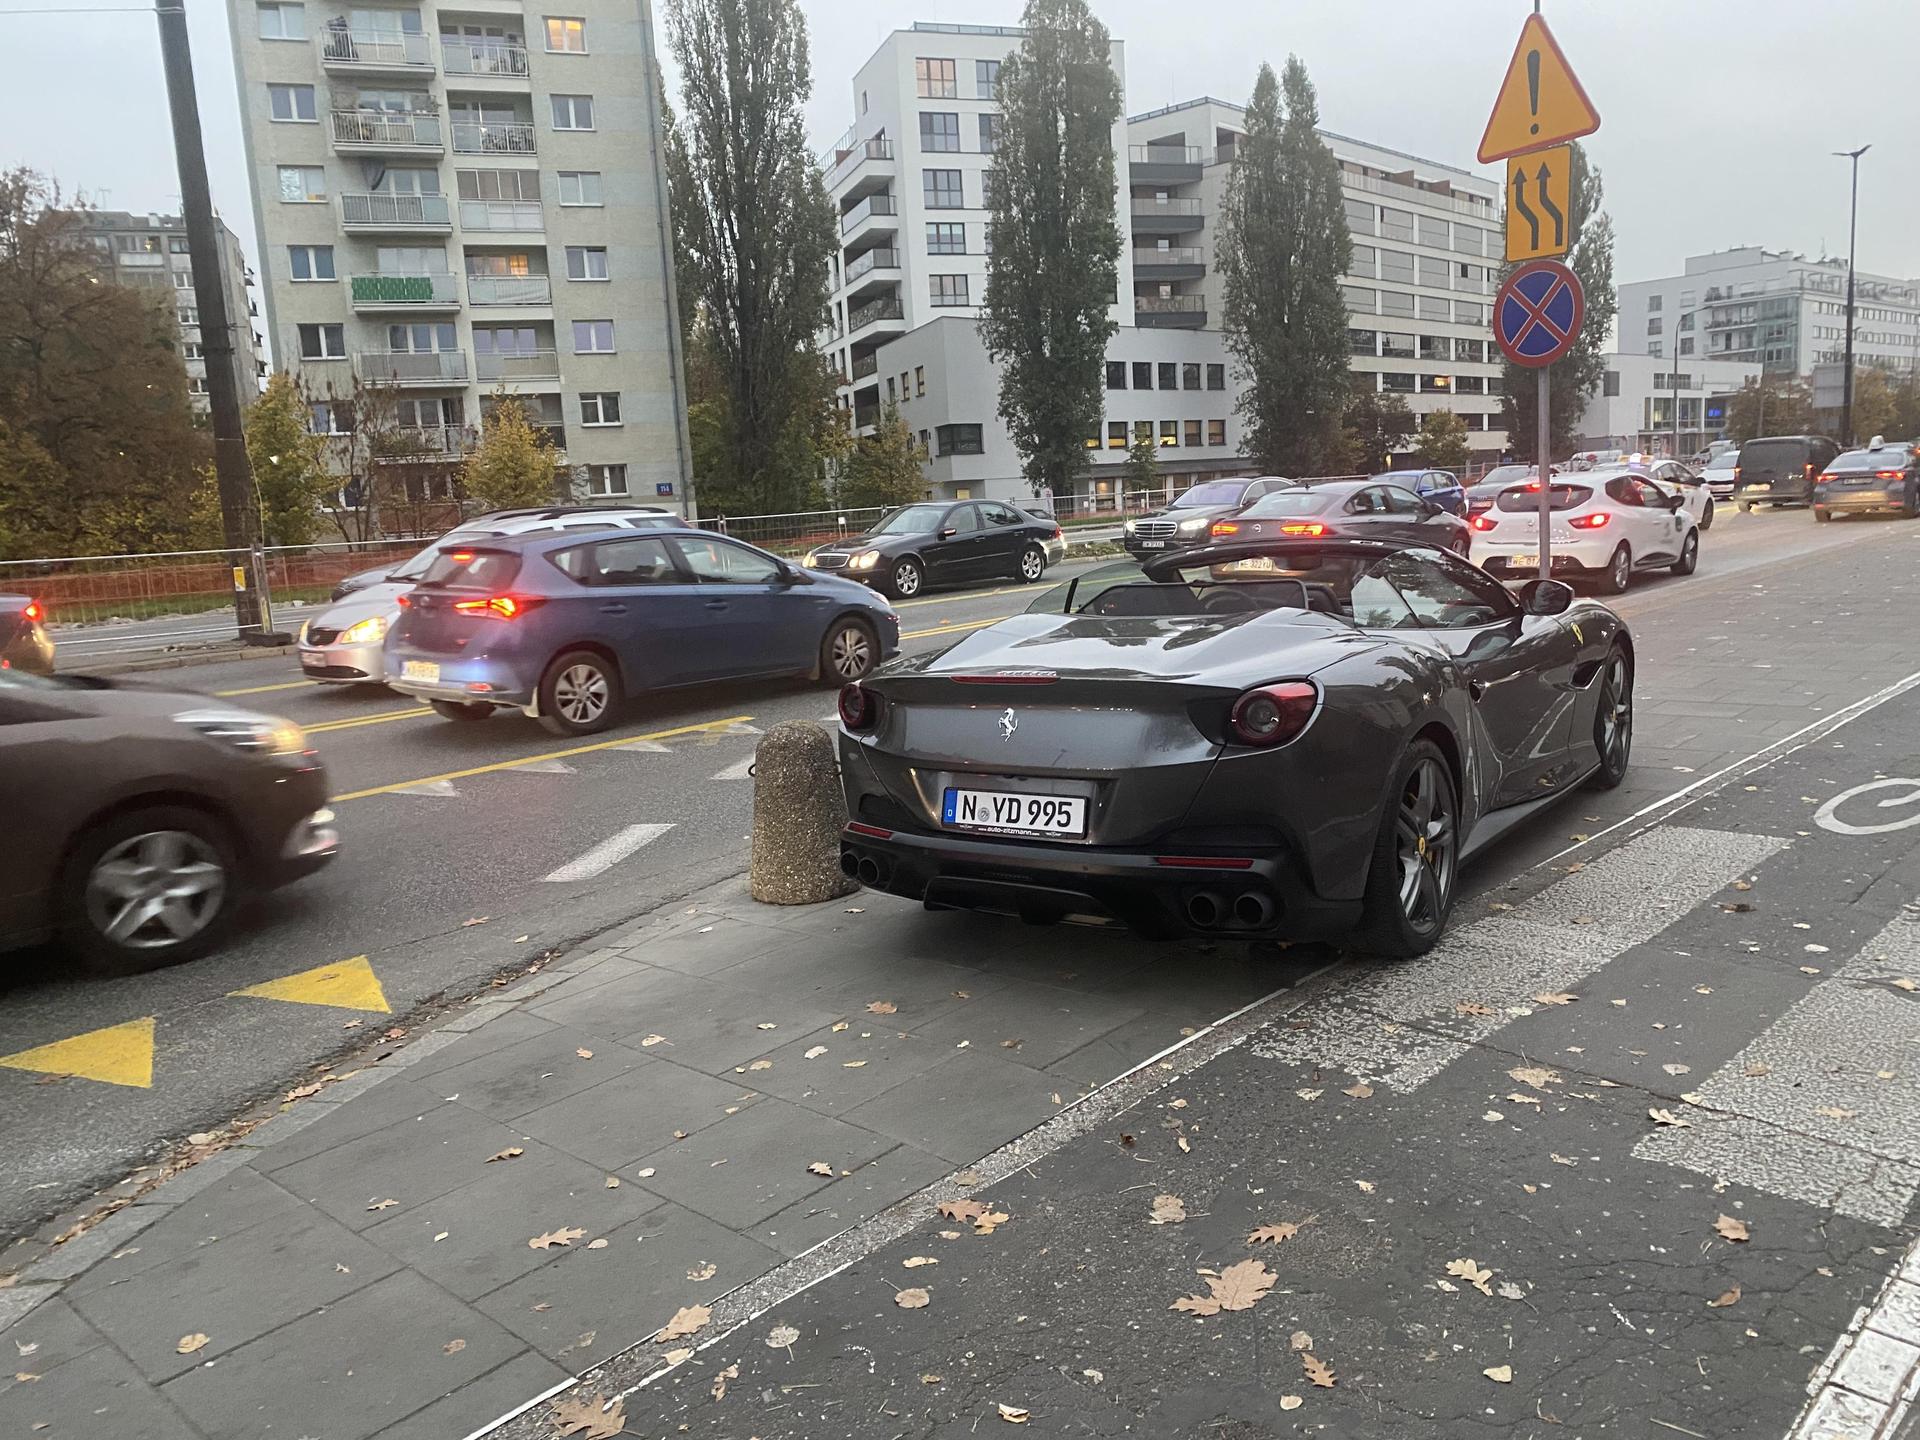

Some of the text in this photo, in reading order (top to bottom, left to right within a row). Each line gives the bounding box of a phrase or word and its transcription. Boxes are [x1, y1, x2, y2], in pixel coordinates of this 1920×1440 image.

[962, 794, 1073, 828] N YD 995
